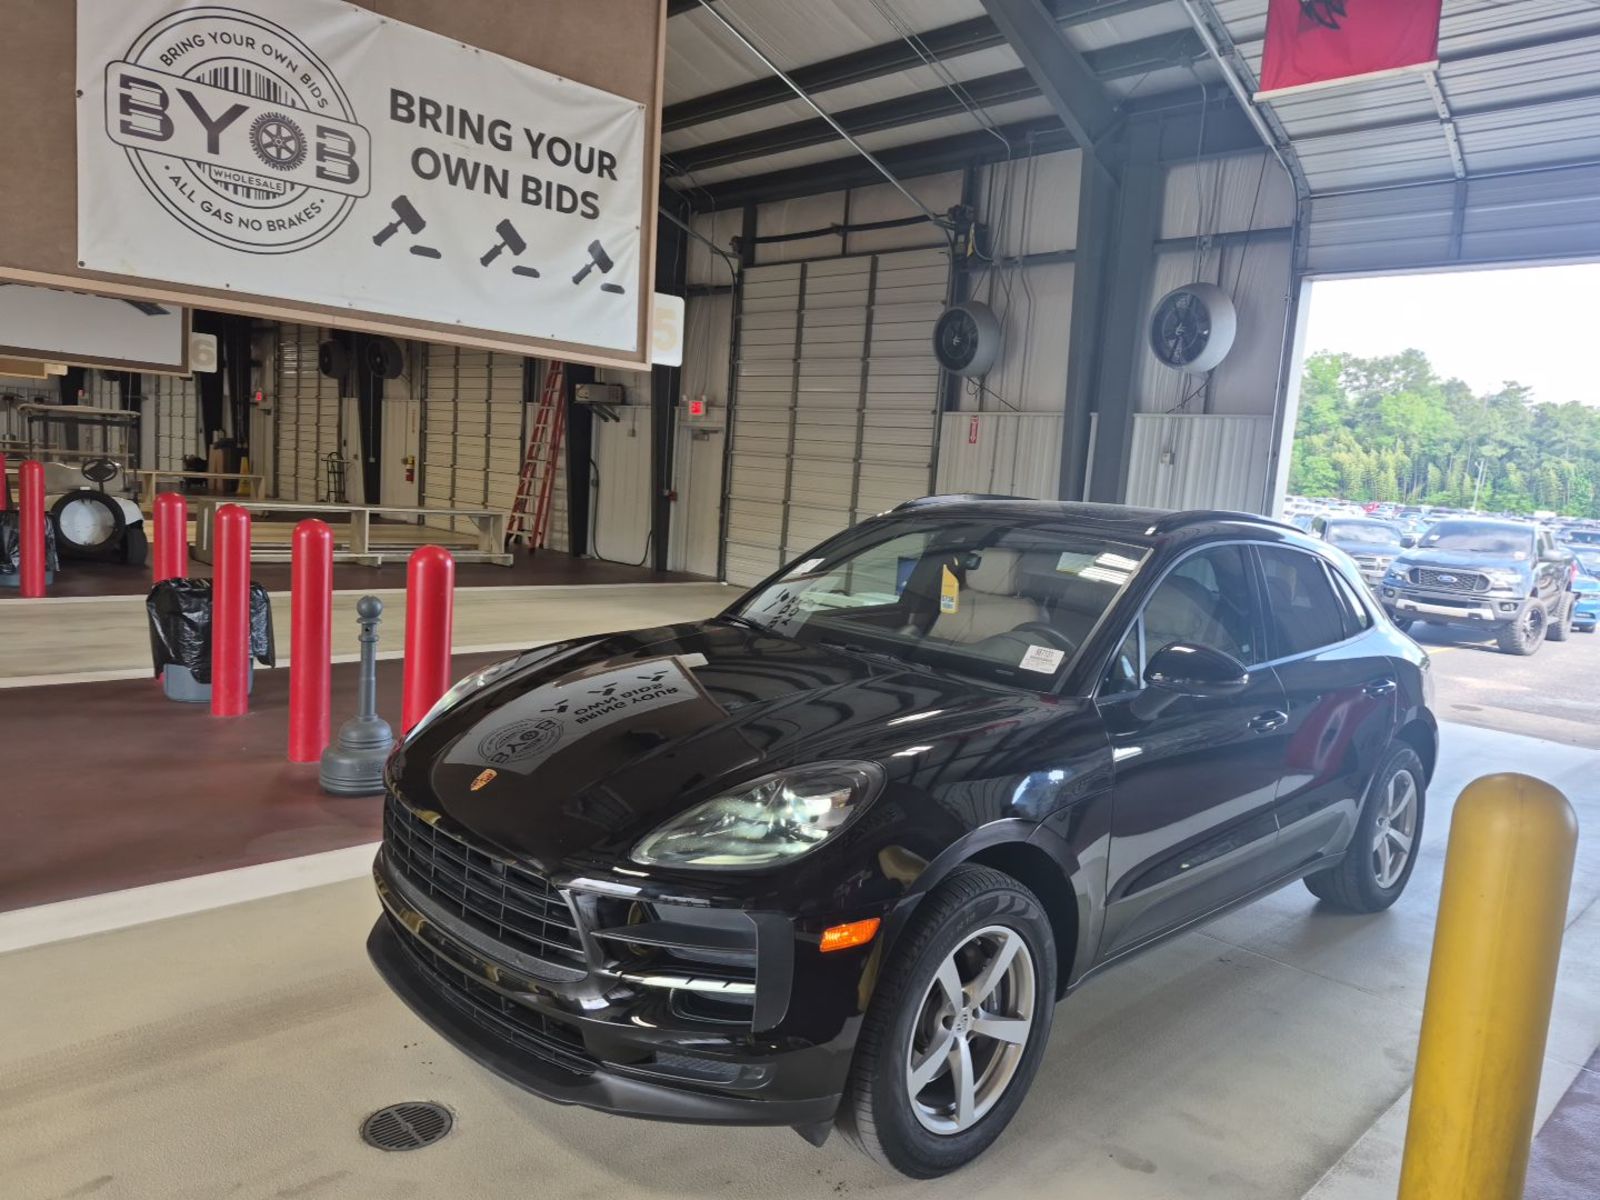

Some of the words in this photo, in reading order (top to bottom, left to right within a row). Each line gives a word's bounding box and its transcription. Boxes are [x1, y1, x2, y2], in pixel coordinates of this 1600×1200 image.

[159, 34, 206, 67] BRING
[208, 32, 256, 50] YOUR
[261, 44, 298, 73] OWN
[299, 73, 329, 109] BIDS
[389, 88, 513, 152] BRING
[523, 128, 618, 181] YOUR
[169, 174, 196, 203] ALL
[200, 201, 234, 225] GAS
[238, 218, 263, 232] NO
[266, 201, 322, 232] BRAKES
[213, 169, 283, 192] WHOLESALE
[411, 147, 509, 200] OWN
[521, 174, 600, 220] BIDS
[192, 339, 215, 366] 6
[654, 308, 678, 350] 5
